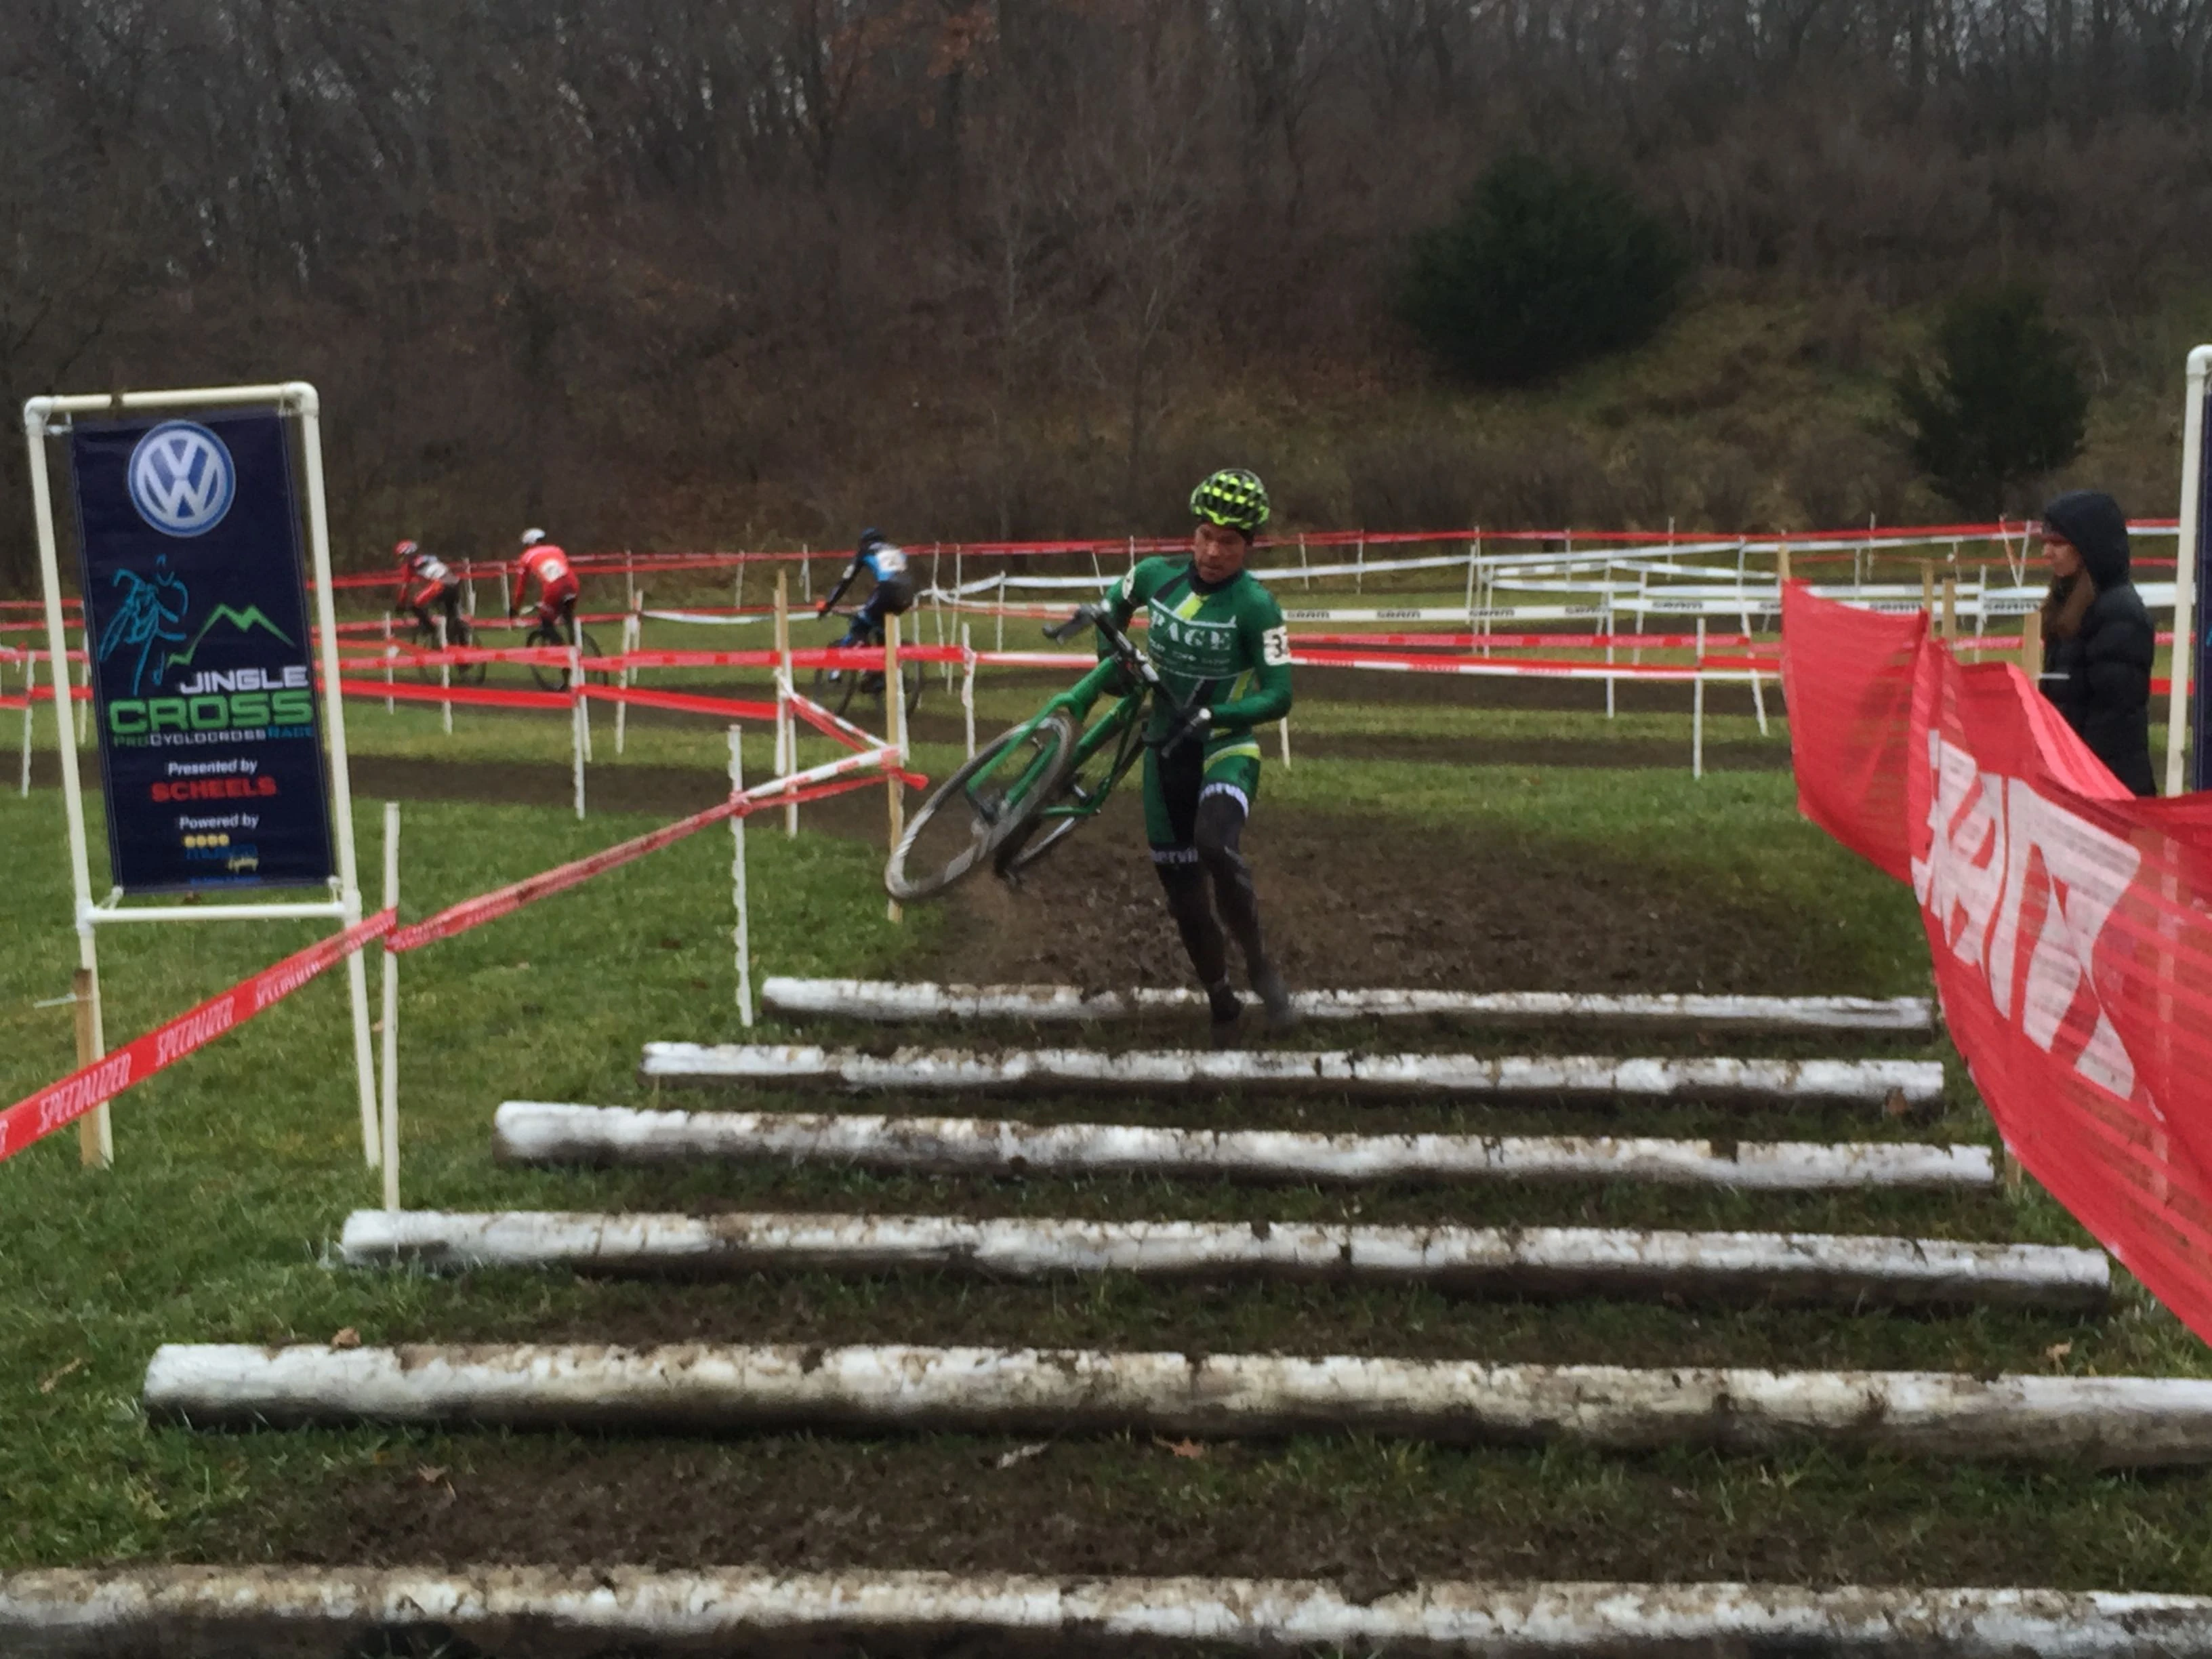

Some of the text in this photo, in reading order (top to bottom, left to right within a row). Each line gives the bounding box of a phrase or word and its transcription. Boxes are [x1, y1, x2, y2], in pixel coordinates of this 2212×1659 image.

[1151, 610, 1233, 651] PAGE
[179, 665, 308, 695] JINGLE
[108, 690, 313, 734] CROSS
[168, 757, 258, 777] Presented by
[151, 775, 276, 803] SCHEELS
[178, 813, 259, 830] Powered by
[156, 996, 235, 1067] SPECIALIZED
[37, 1052, 132, 1135] SPECIALIZED
